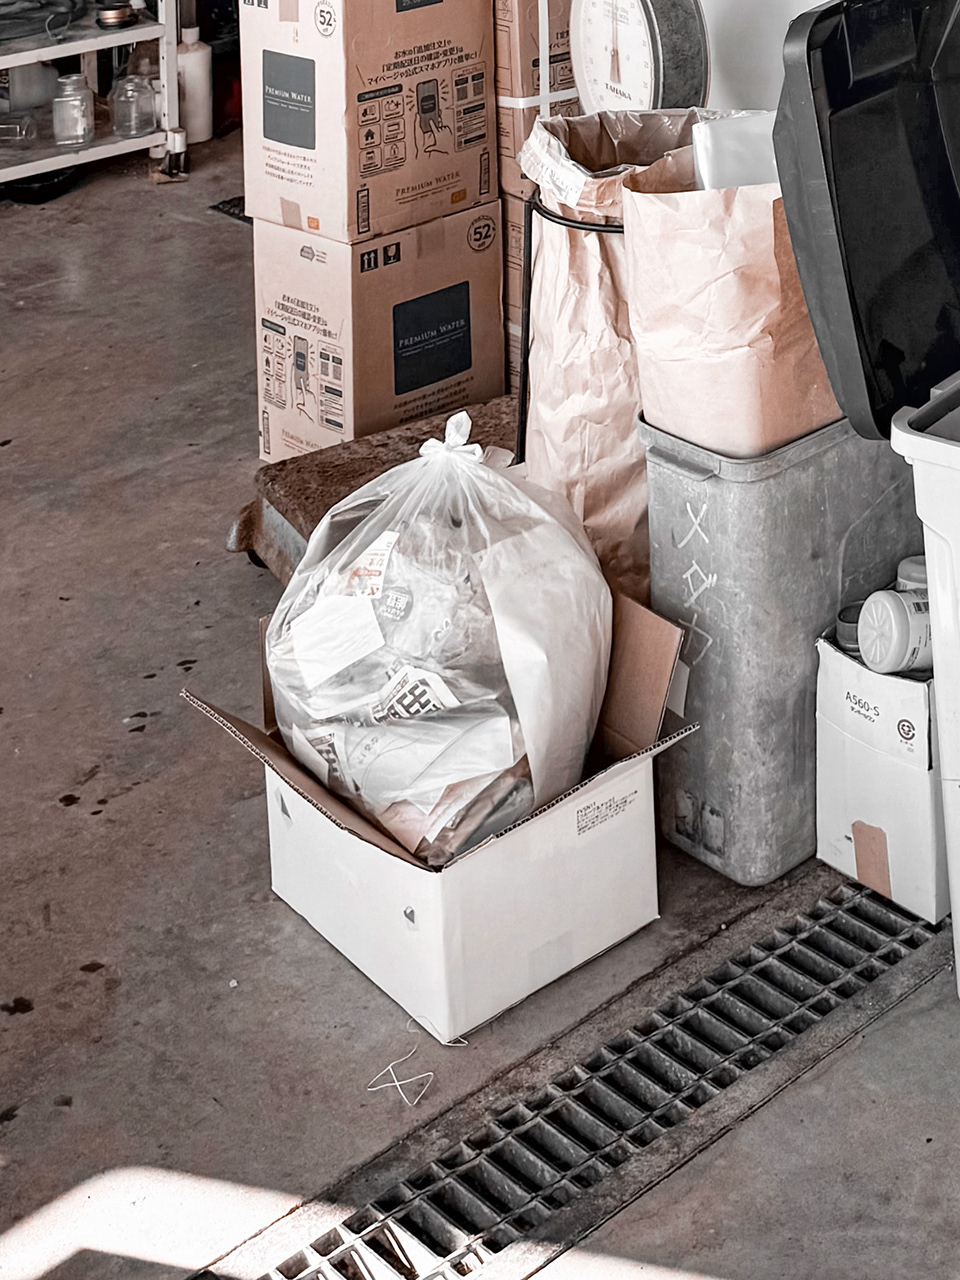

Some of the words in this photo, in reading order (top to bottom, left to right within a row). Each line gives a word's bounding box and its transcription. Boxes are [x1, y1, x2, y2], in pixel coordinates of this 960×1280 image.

[319, 9, 333, 27] 52
[265, 85, 289, 98] PREMIUM
[291, 91, 312, 103] WATER
[604, 82, 632, 101] TANAKA
[396, 181, 433, 197] PREMIUM
[435, 171, 460, 184] WATER
[473, 224, 491, 242] 52
[399, 330, 437, 348] PREMIUM
[439, 319, 466, 333] WATER
[846, 691, 880, 717] A560-S
